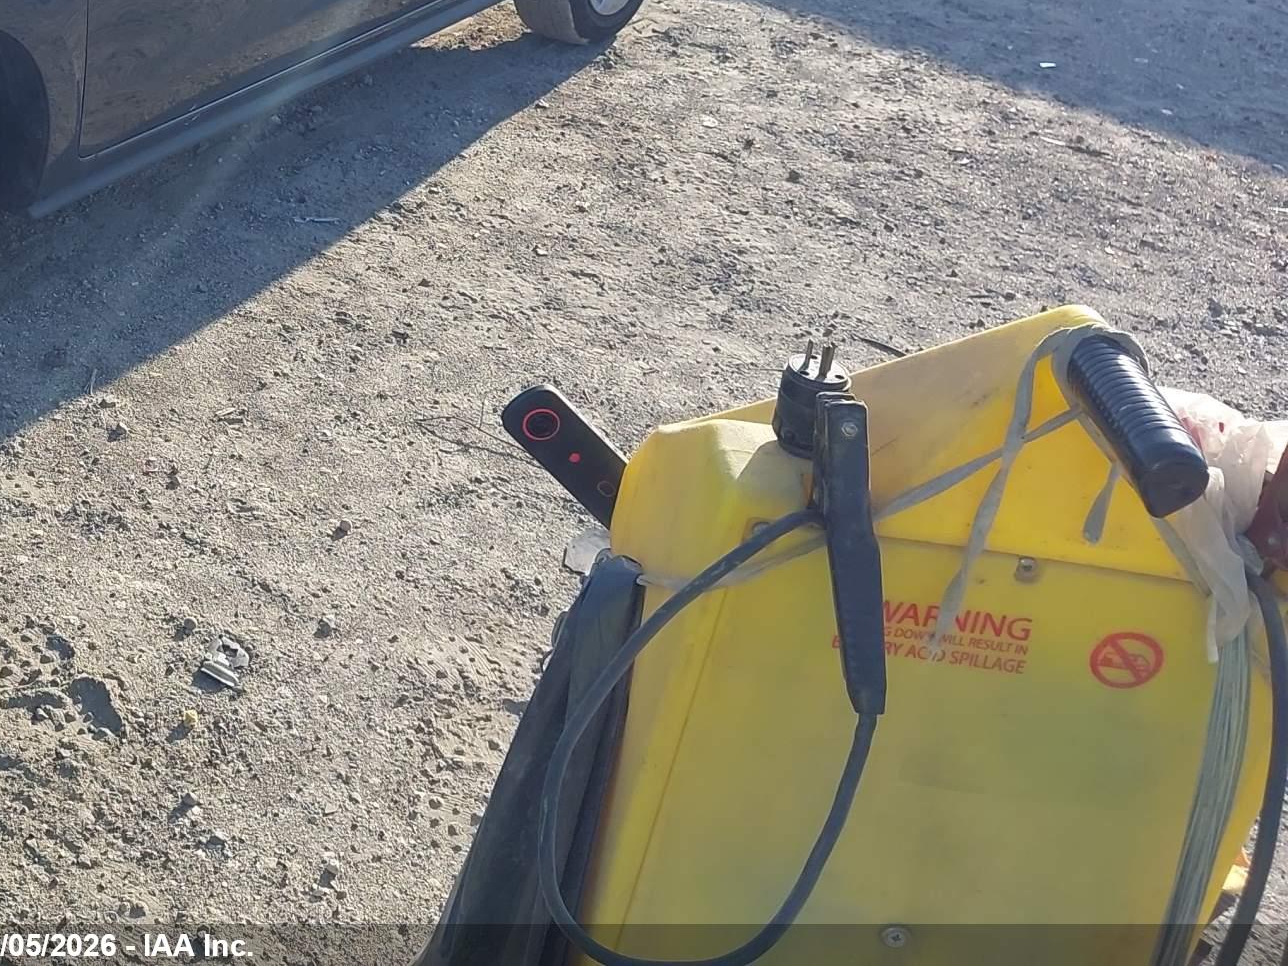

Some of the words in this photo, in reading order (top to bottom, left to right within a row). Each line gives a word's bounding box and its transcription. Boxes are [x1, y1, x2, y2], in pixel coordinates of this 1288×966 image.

[968, 637, 1013, 652] RESULT
[1015, 643, 1029, 656] IN
[949, 650, 1028, 675] SPILLAGE
